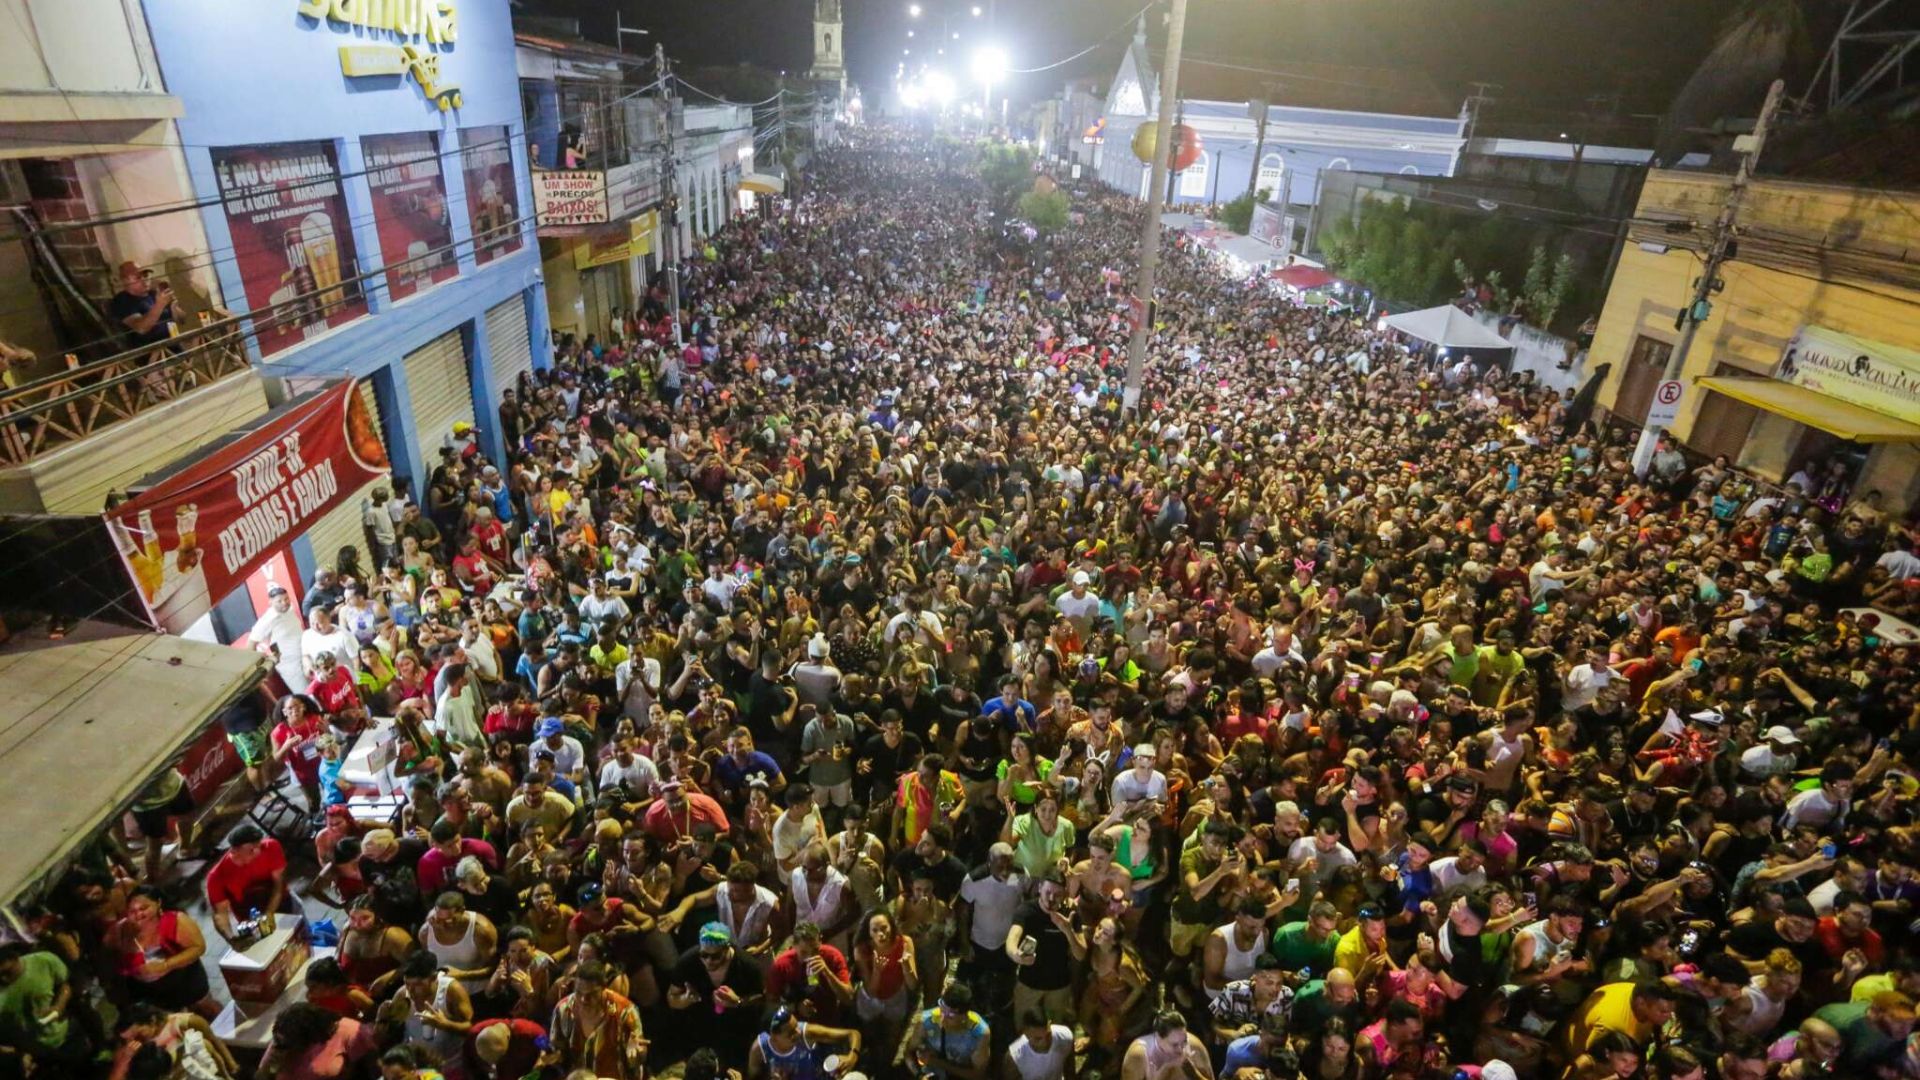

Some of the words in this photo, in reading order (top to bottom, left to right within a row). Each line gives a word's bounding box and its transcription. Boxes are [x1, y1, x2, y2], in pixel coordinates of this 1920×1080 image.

[218, 160, 233, 190] É
[231, 162, 259, 188] NO
[259, 154, 335, 184] CARNAVAL
[545, 181, 560, 190] UM
[563, 180, 593, 190] SHOW
[230, 431, 306, 509] VENDE-SE
[218, 493, 290, 576] BEBIDAS
[280, 485, 300, 527] E
[291, 457, 338, 519] CALDO
